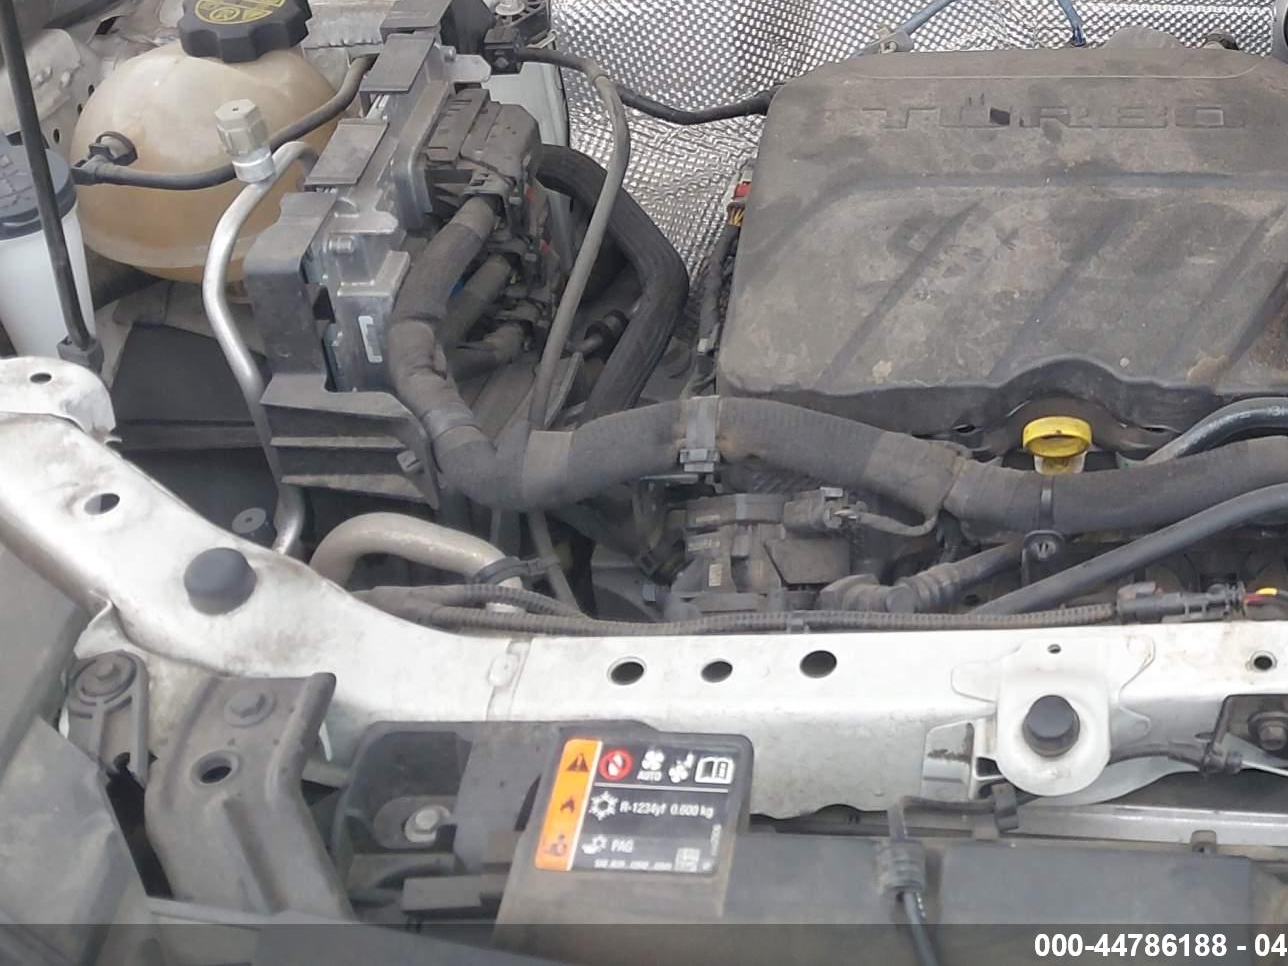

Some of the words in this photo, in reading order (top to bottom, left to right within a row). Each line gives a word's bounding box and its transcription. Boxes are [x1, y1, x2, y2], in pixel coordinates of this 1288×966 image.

[862, 105, 1247, 129] TURBO
[636, 770, 662, 782] AUTO
[619, 801, 667, 817] R-1234yf
[700, 805, 714, 819] kg
[611, 838, 634, 854] PAG
